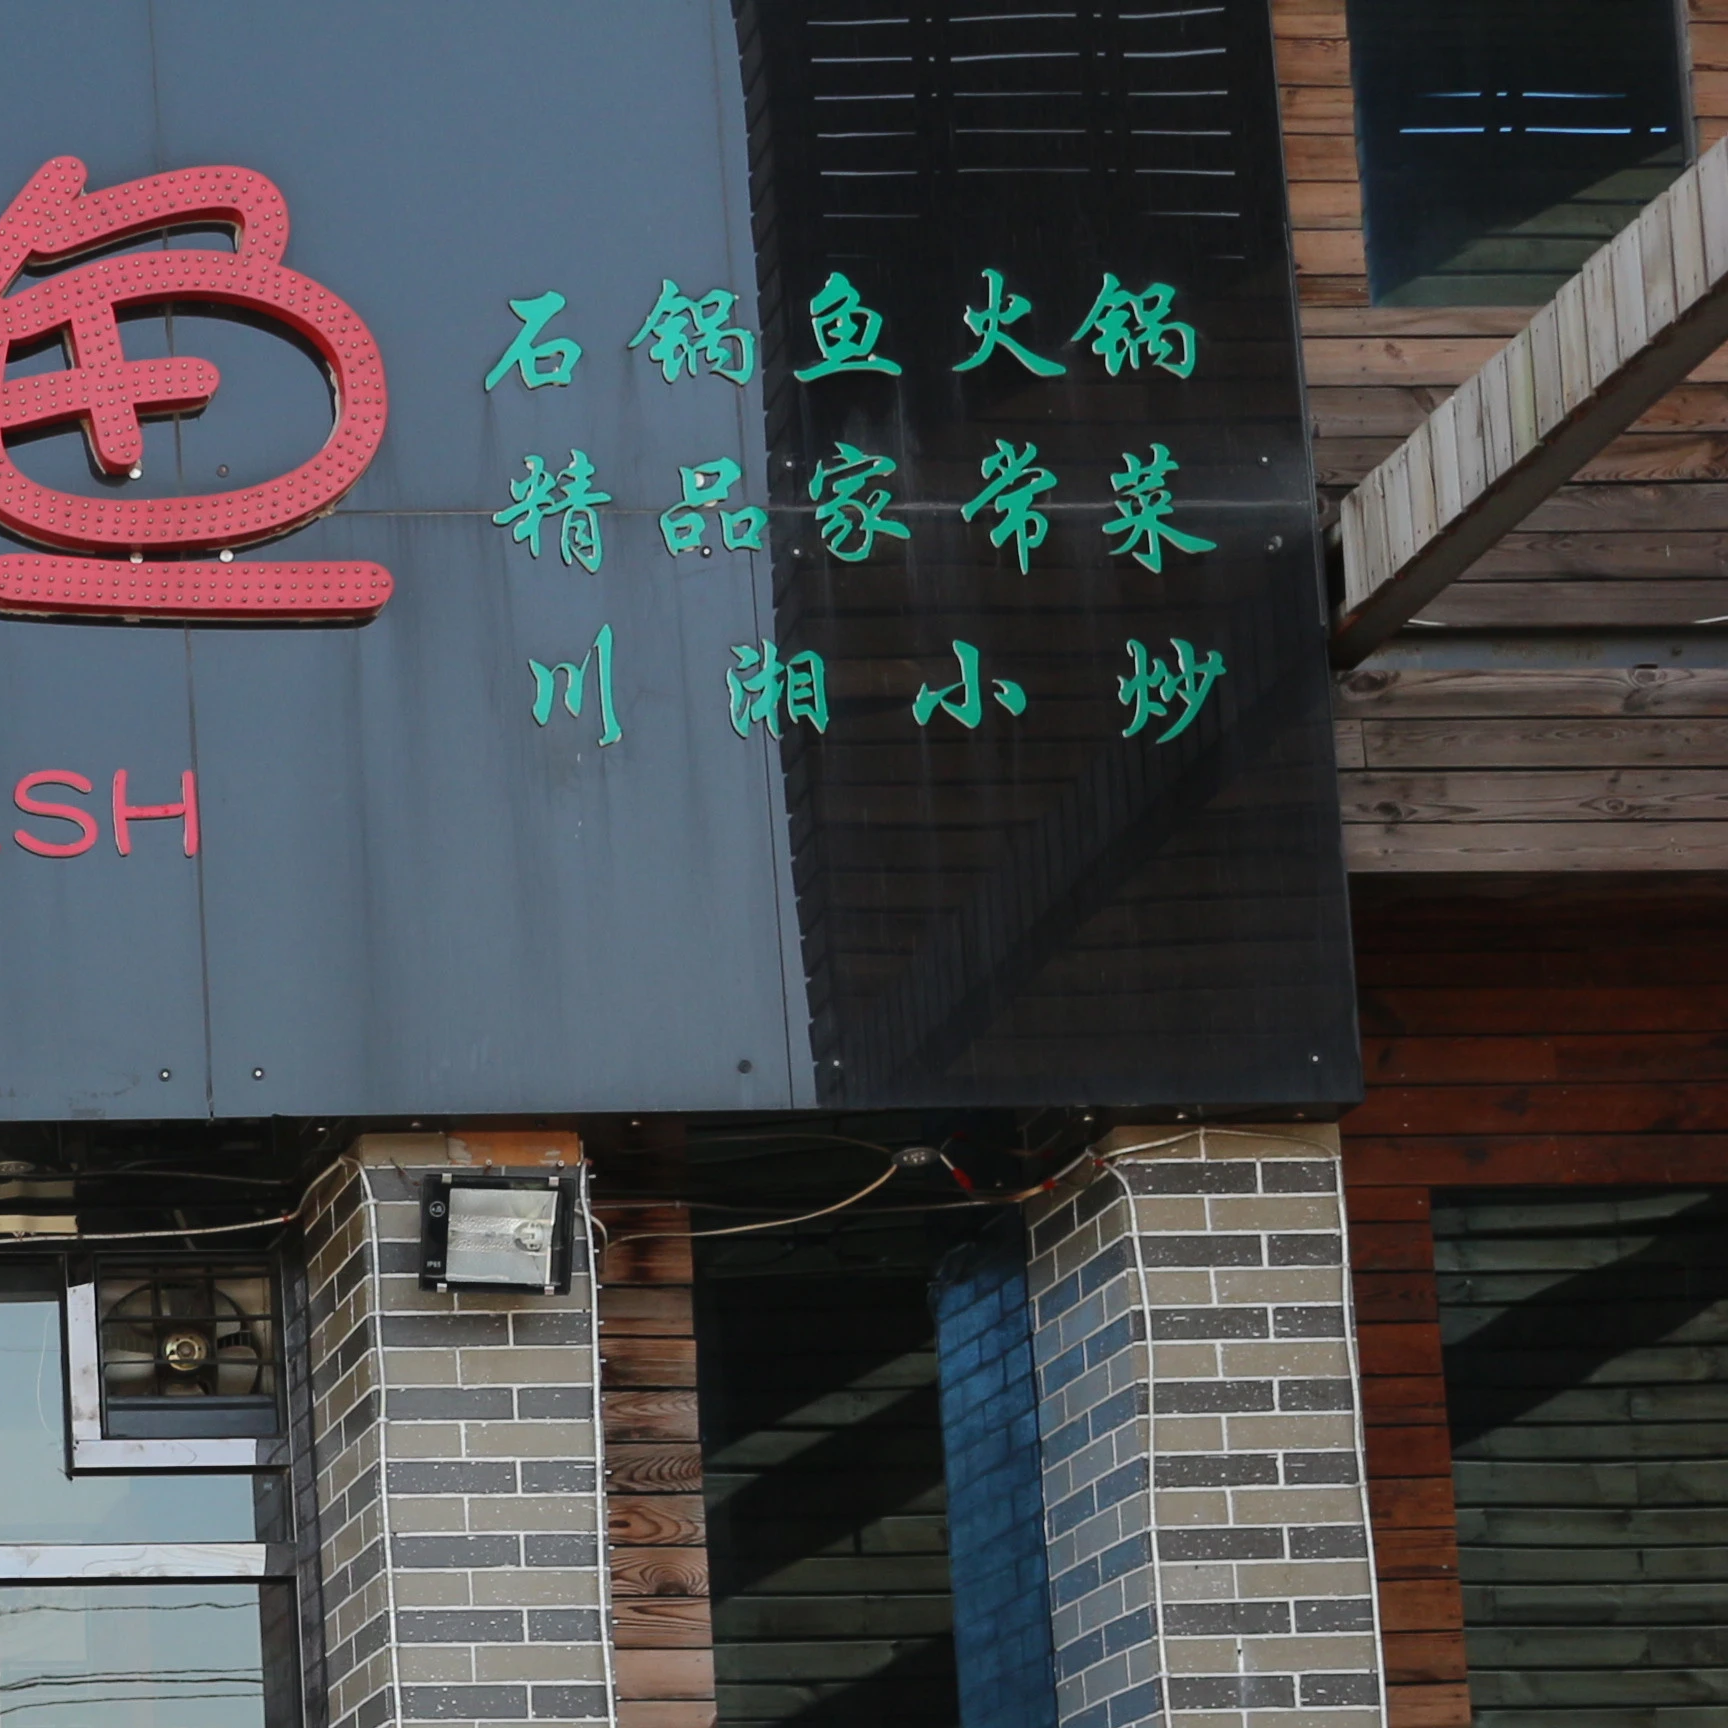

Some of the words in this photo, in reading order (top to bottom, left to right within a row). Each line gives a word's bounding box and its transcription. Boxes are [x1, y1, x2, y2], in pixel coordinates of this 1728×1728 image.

[484, 268, 1197, 391] 石锅鱼火锅
[493, 438, 1218, 575] 精品家常菜
[528, 623, 1228, 748] 川湘小炒
